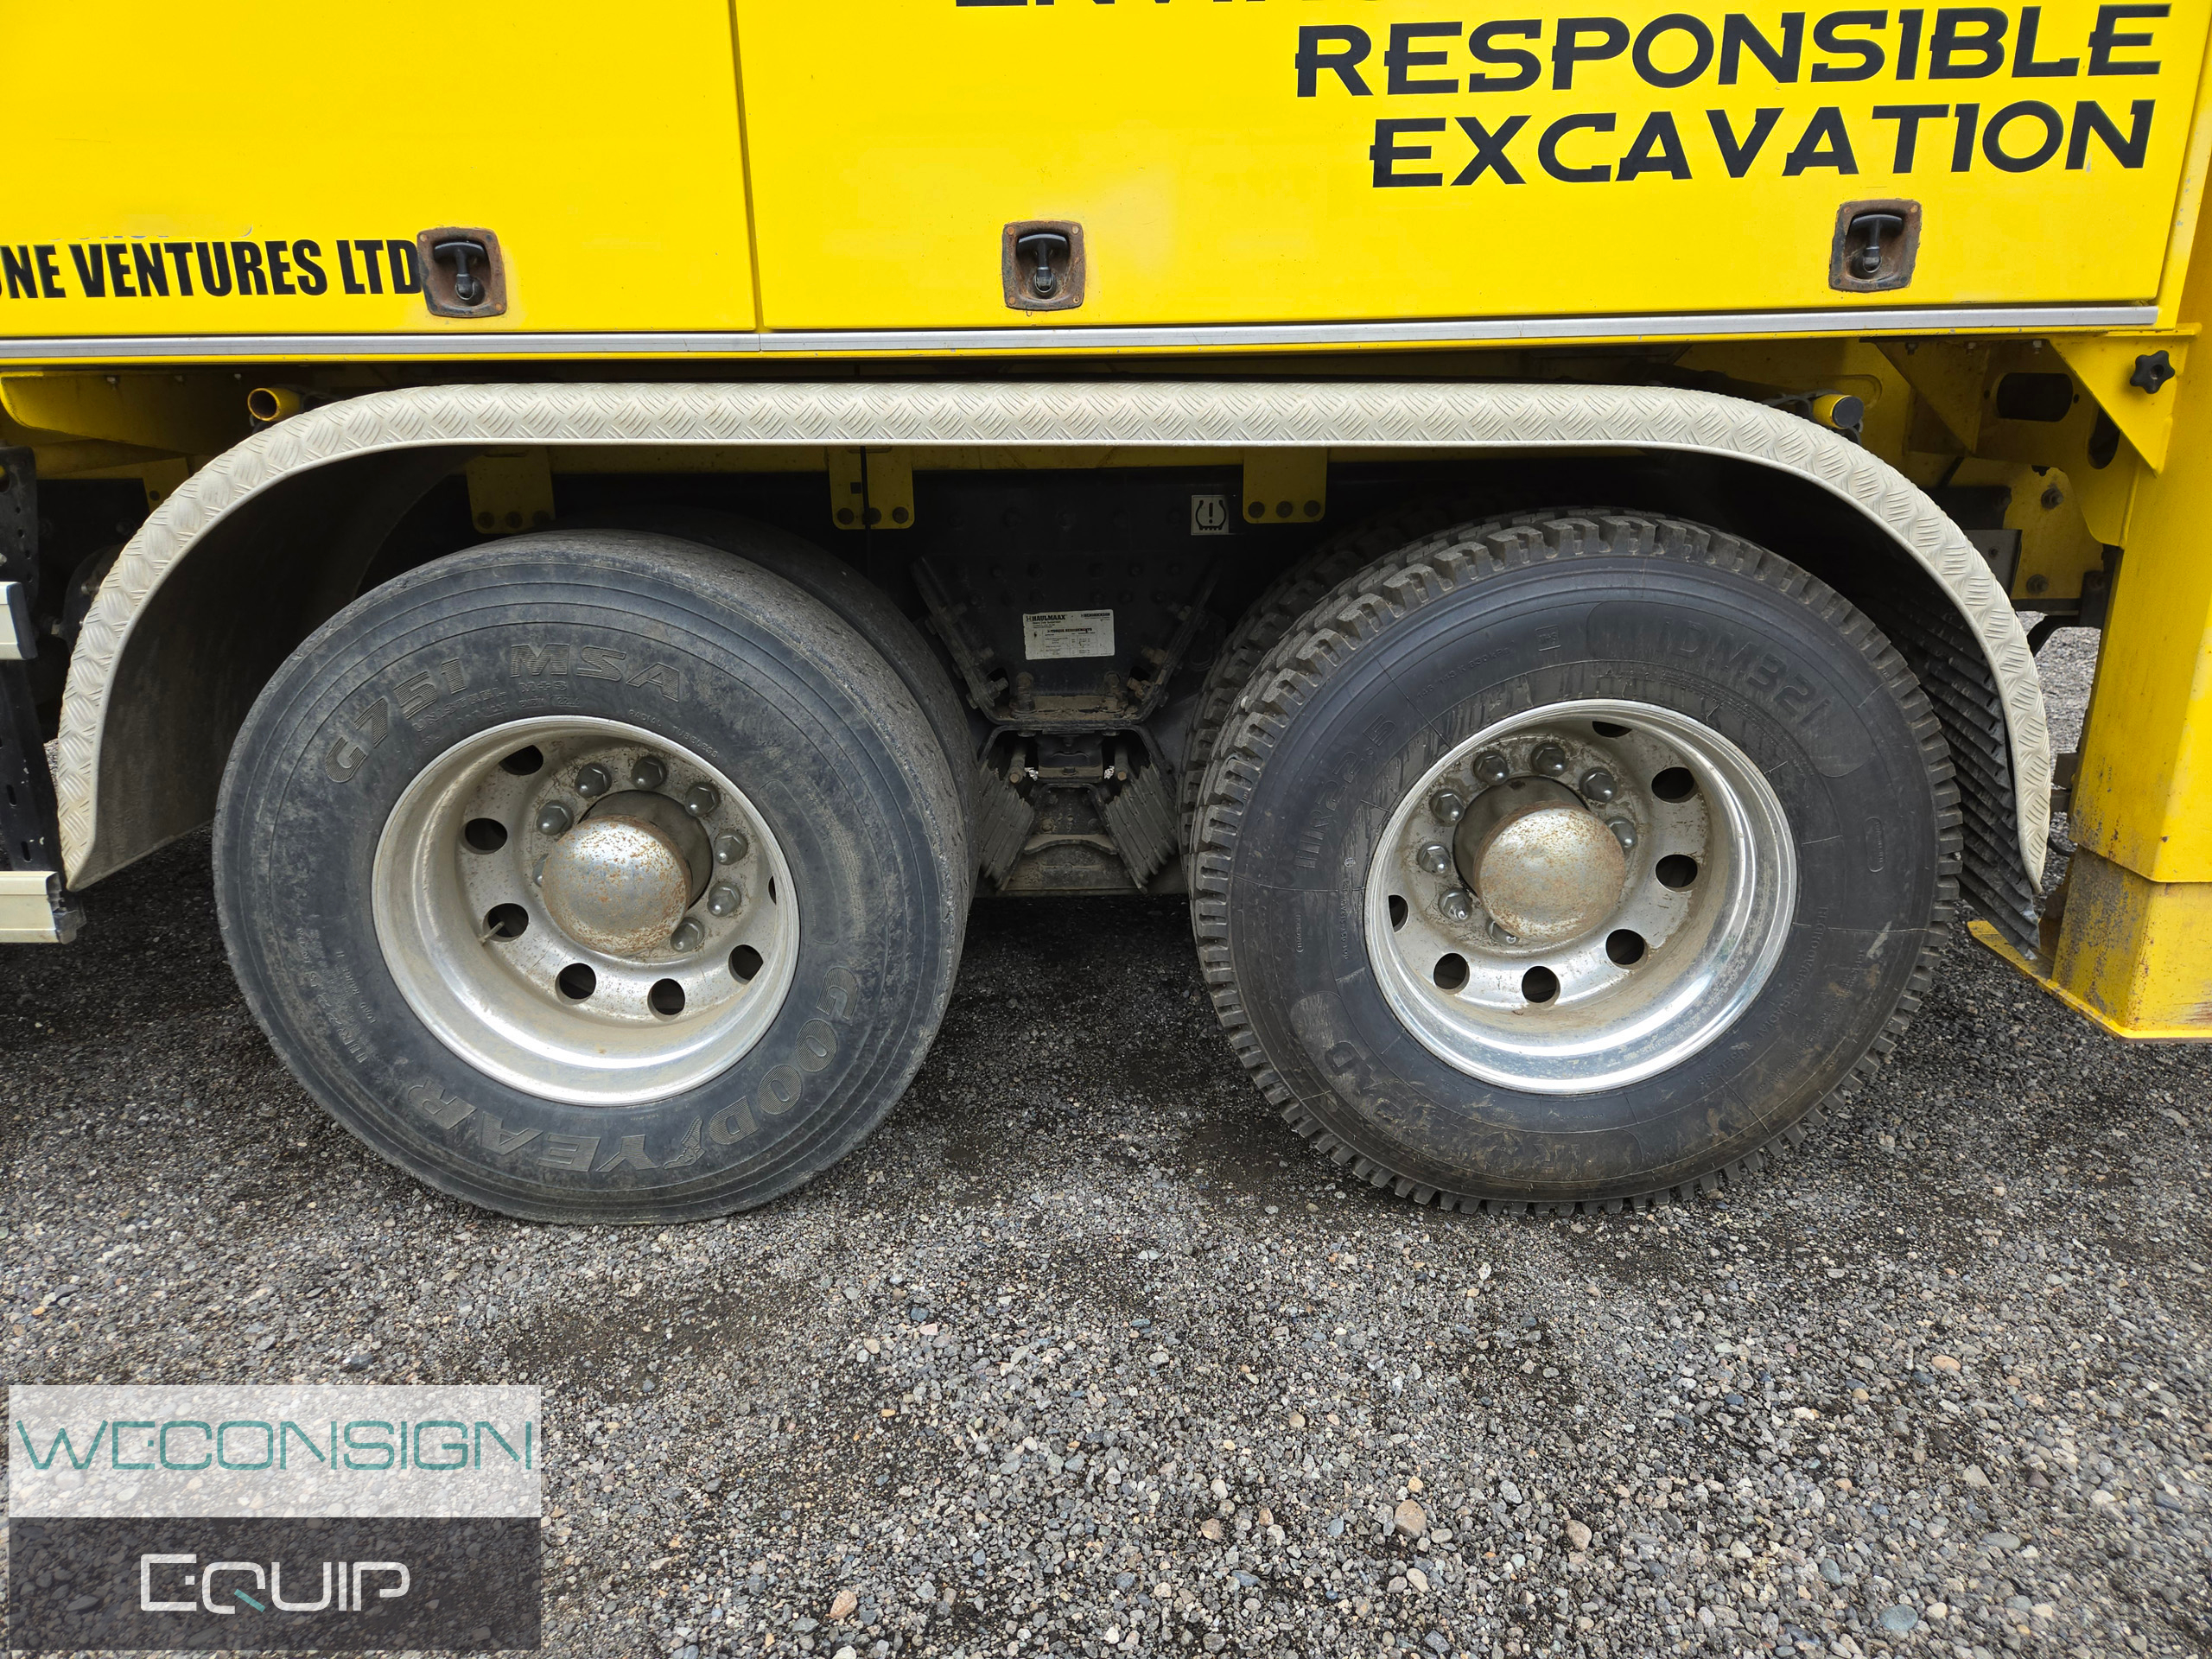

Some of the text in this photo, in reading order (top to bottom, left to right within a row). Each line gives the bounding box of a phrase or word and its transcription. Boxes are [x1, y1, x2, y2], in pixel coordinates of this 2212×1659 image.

[1295, 4, 2171, 97] RESPONSIBLE
[1370, 99, 2156, 188] EXCAVATION
[0, 239, 423, 298] NE VENTURES LTD
[325, 644, 681, 783] G751 MSA
[407, 966, 860, 1173] GOODYEAR
